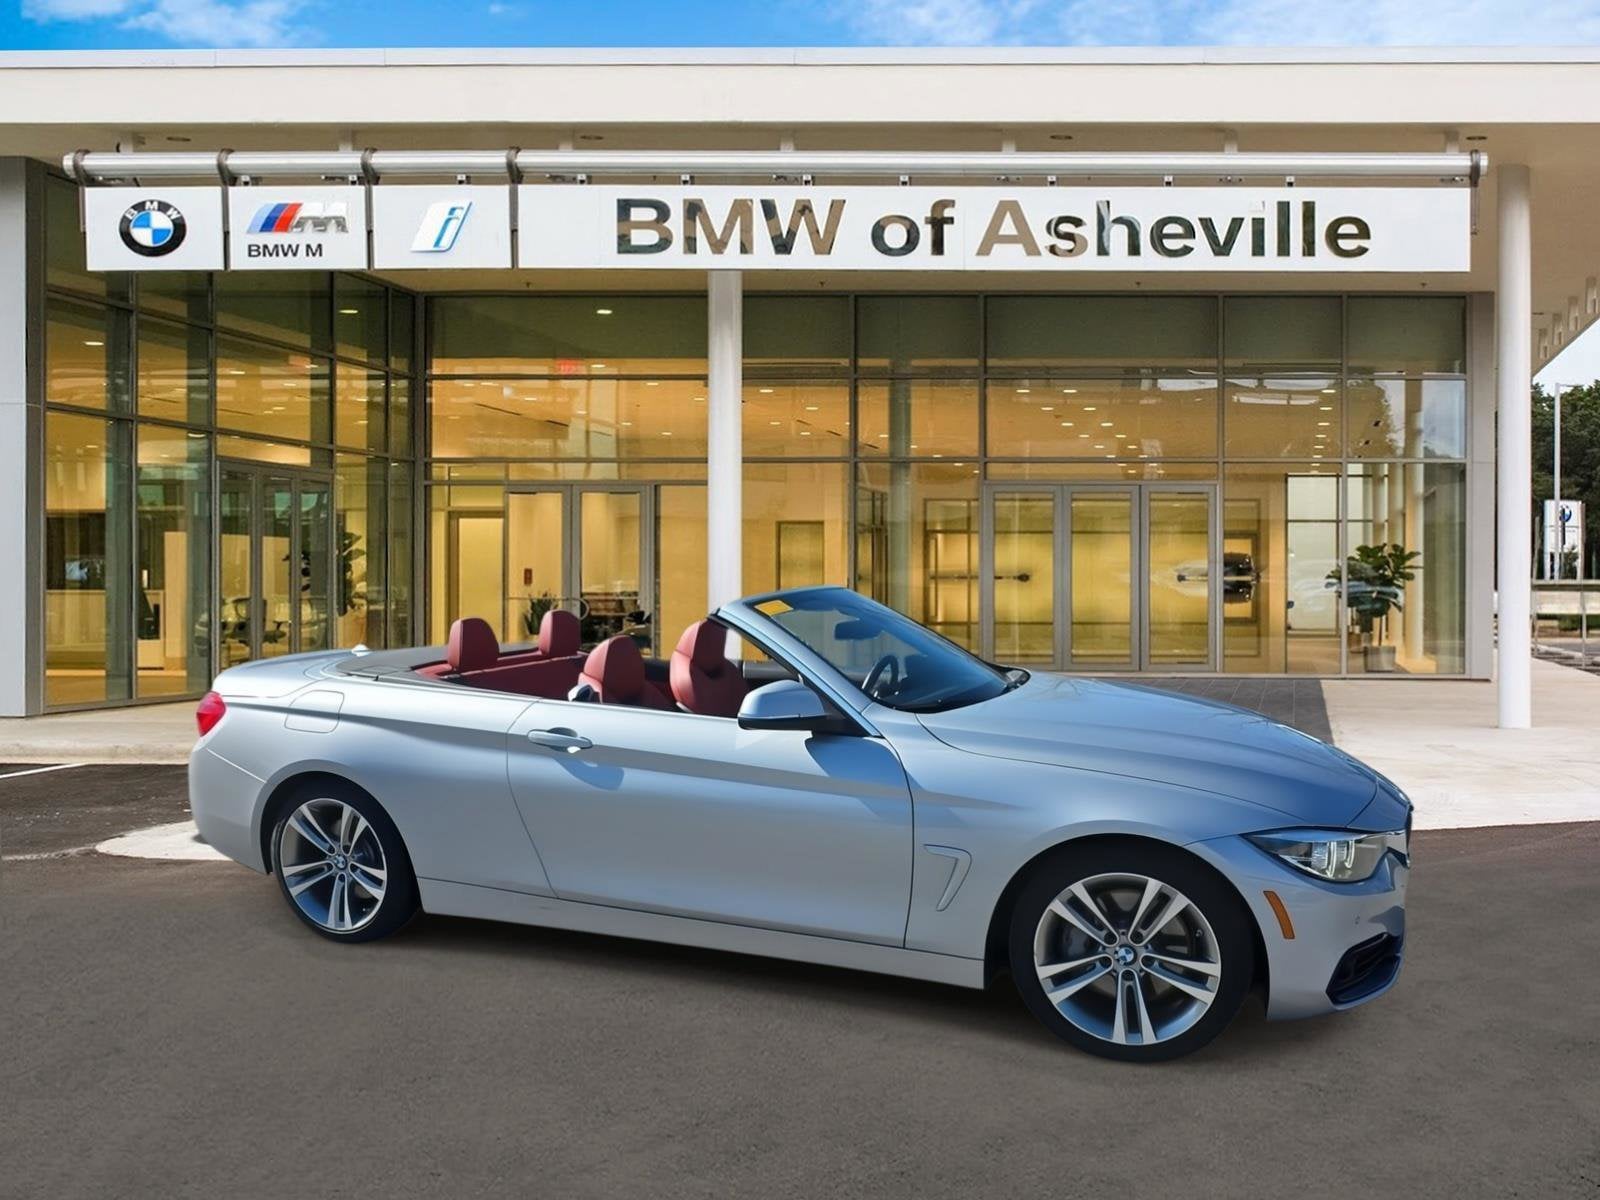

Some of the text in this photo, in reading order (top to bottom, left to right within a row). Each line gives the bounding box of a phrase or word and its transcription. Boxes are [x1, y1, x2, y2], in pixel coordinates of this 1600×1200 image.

[124, 200, 181, 220] BMW
[616, 198, 1372, 258] BMW of Asheville
[247, 243, 323, 258] BMW M
